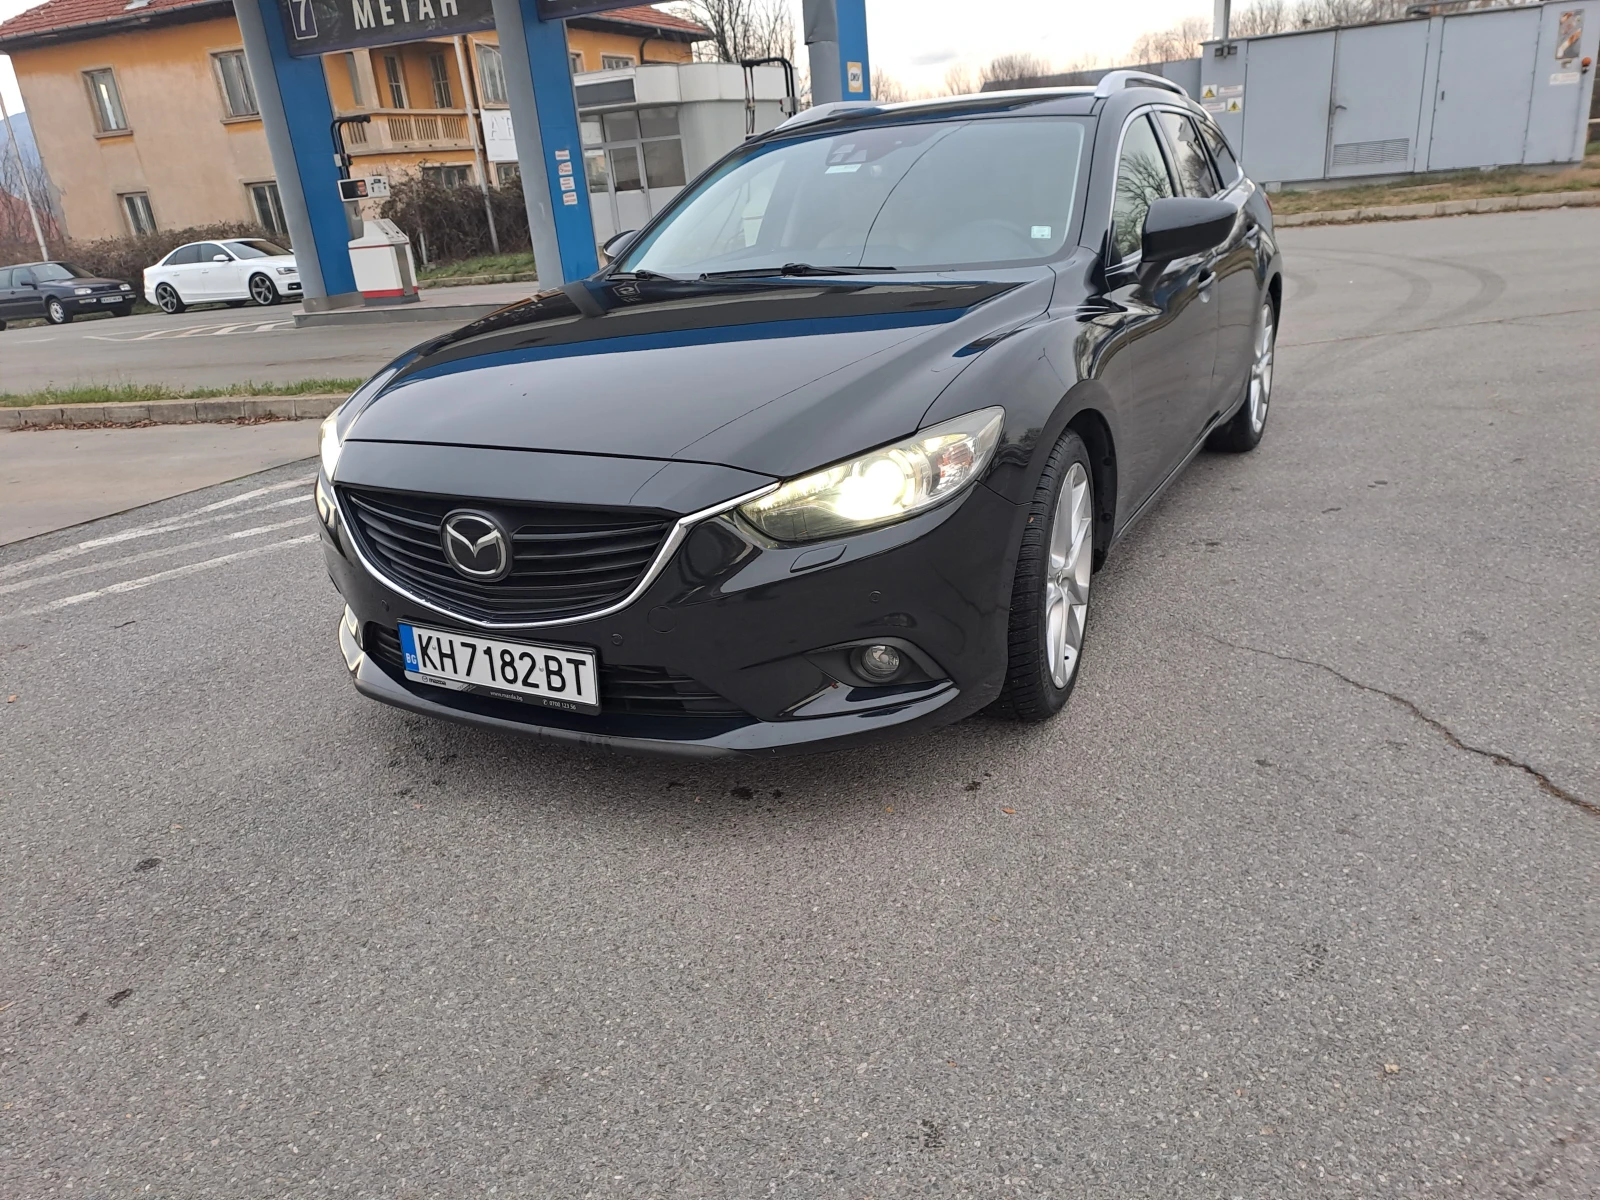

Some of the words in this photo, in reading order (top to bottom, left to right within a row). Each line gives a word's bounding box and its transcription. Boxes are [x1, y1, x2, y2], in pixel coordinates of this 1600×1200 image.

[290, 0, 307, 31] 7
[405, 653, 417, 665] BG
[417, 633, 587, 697] KH7182BT
